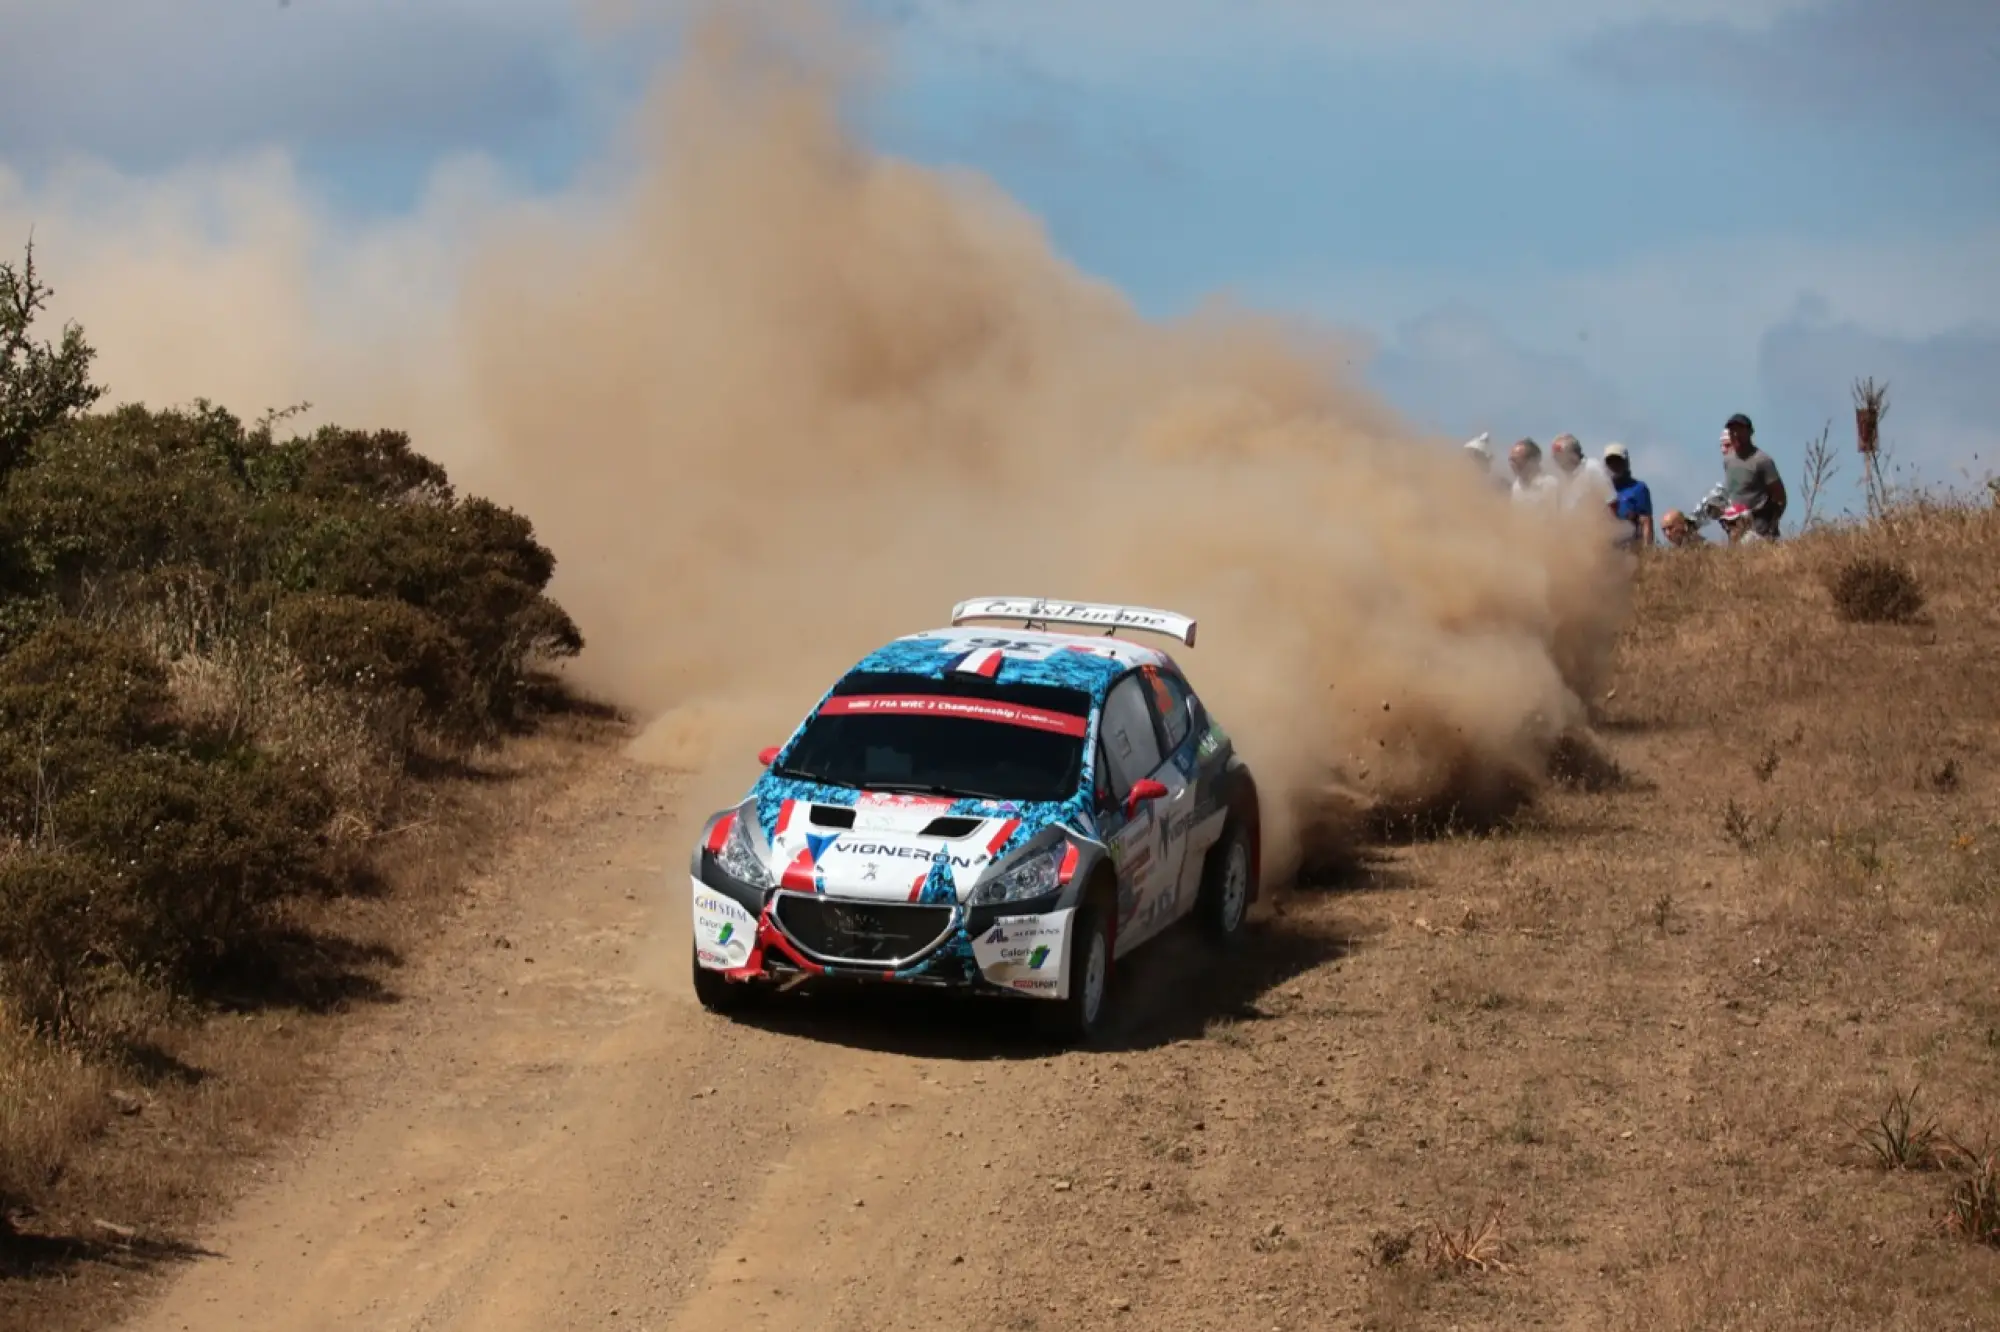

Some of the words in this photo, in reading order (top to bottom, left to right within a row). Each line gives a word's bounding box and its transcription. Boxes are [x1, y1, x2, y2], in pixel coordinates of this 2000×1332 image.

[879, 700, 898, 709] FIA
[900, 700, 925, 709] WRC
[938, 702, 1015, 719] Championship
[834, 841, 972, 869] VIGNERON
